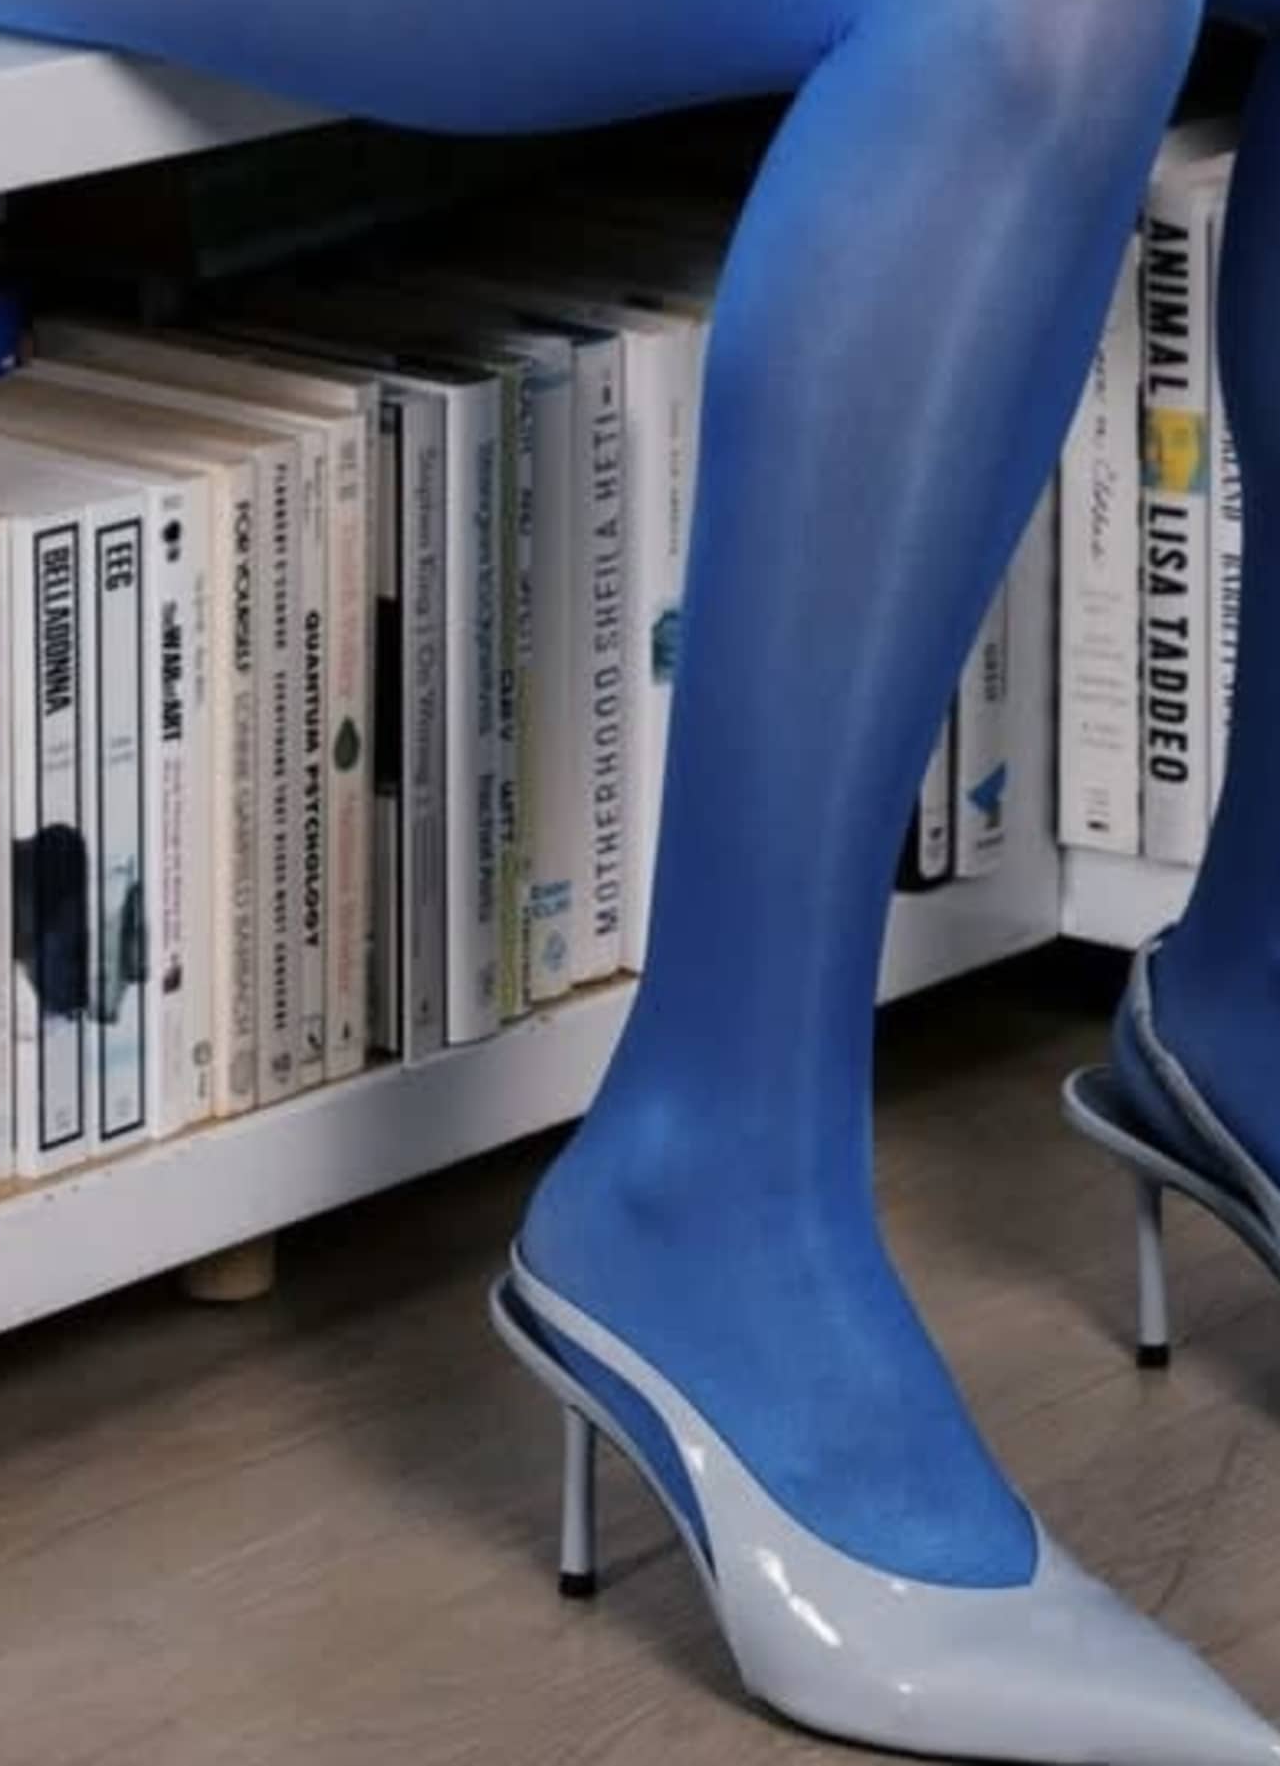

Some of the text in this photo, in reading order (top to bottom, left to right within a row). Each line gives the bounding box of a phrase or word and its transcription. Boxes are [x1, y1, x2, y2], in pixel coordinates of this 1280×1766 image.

[42, 544, 72, 717] BELLADONNA
[104, 540, 134, 593] EEG
[1147, 218, 1189, 785] ANIMAL LISA TADDEO
[304, 609, 321, 949] QUANTUM PSYCHOLOGY
[592, 413, 619, 937] MOTHERHOOD SHEILA HETI
